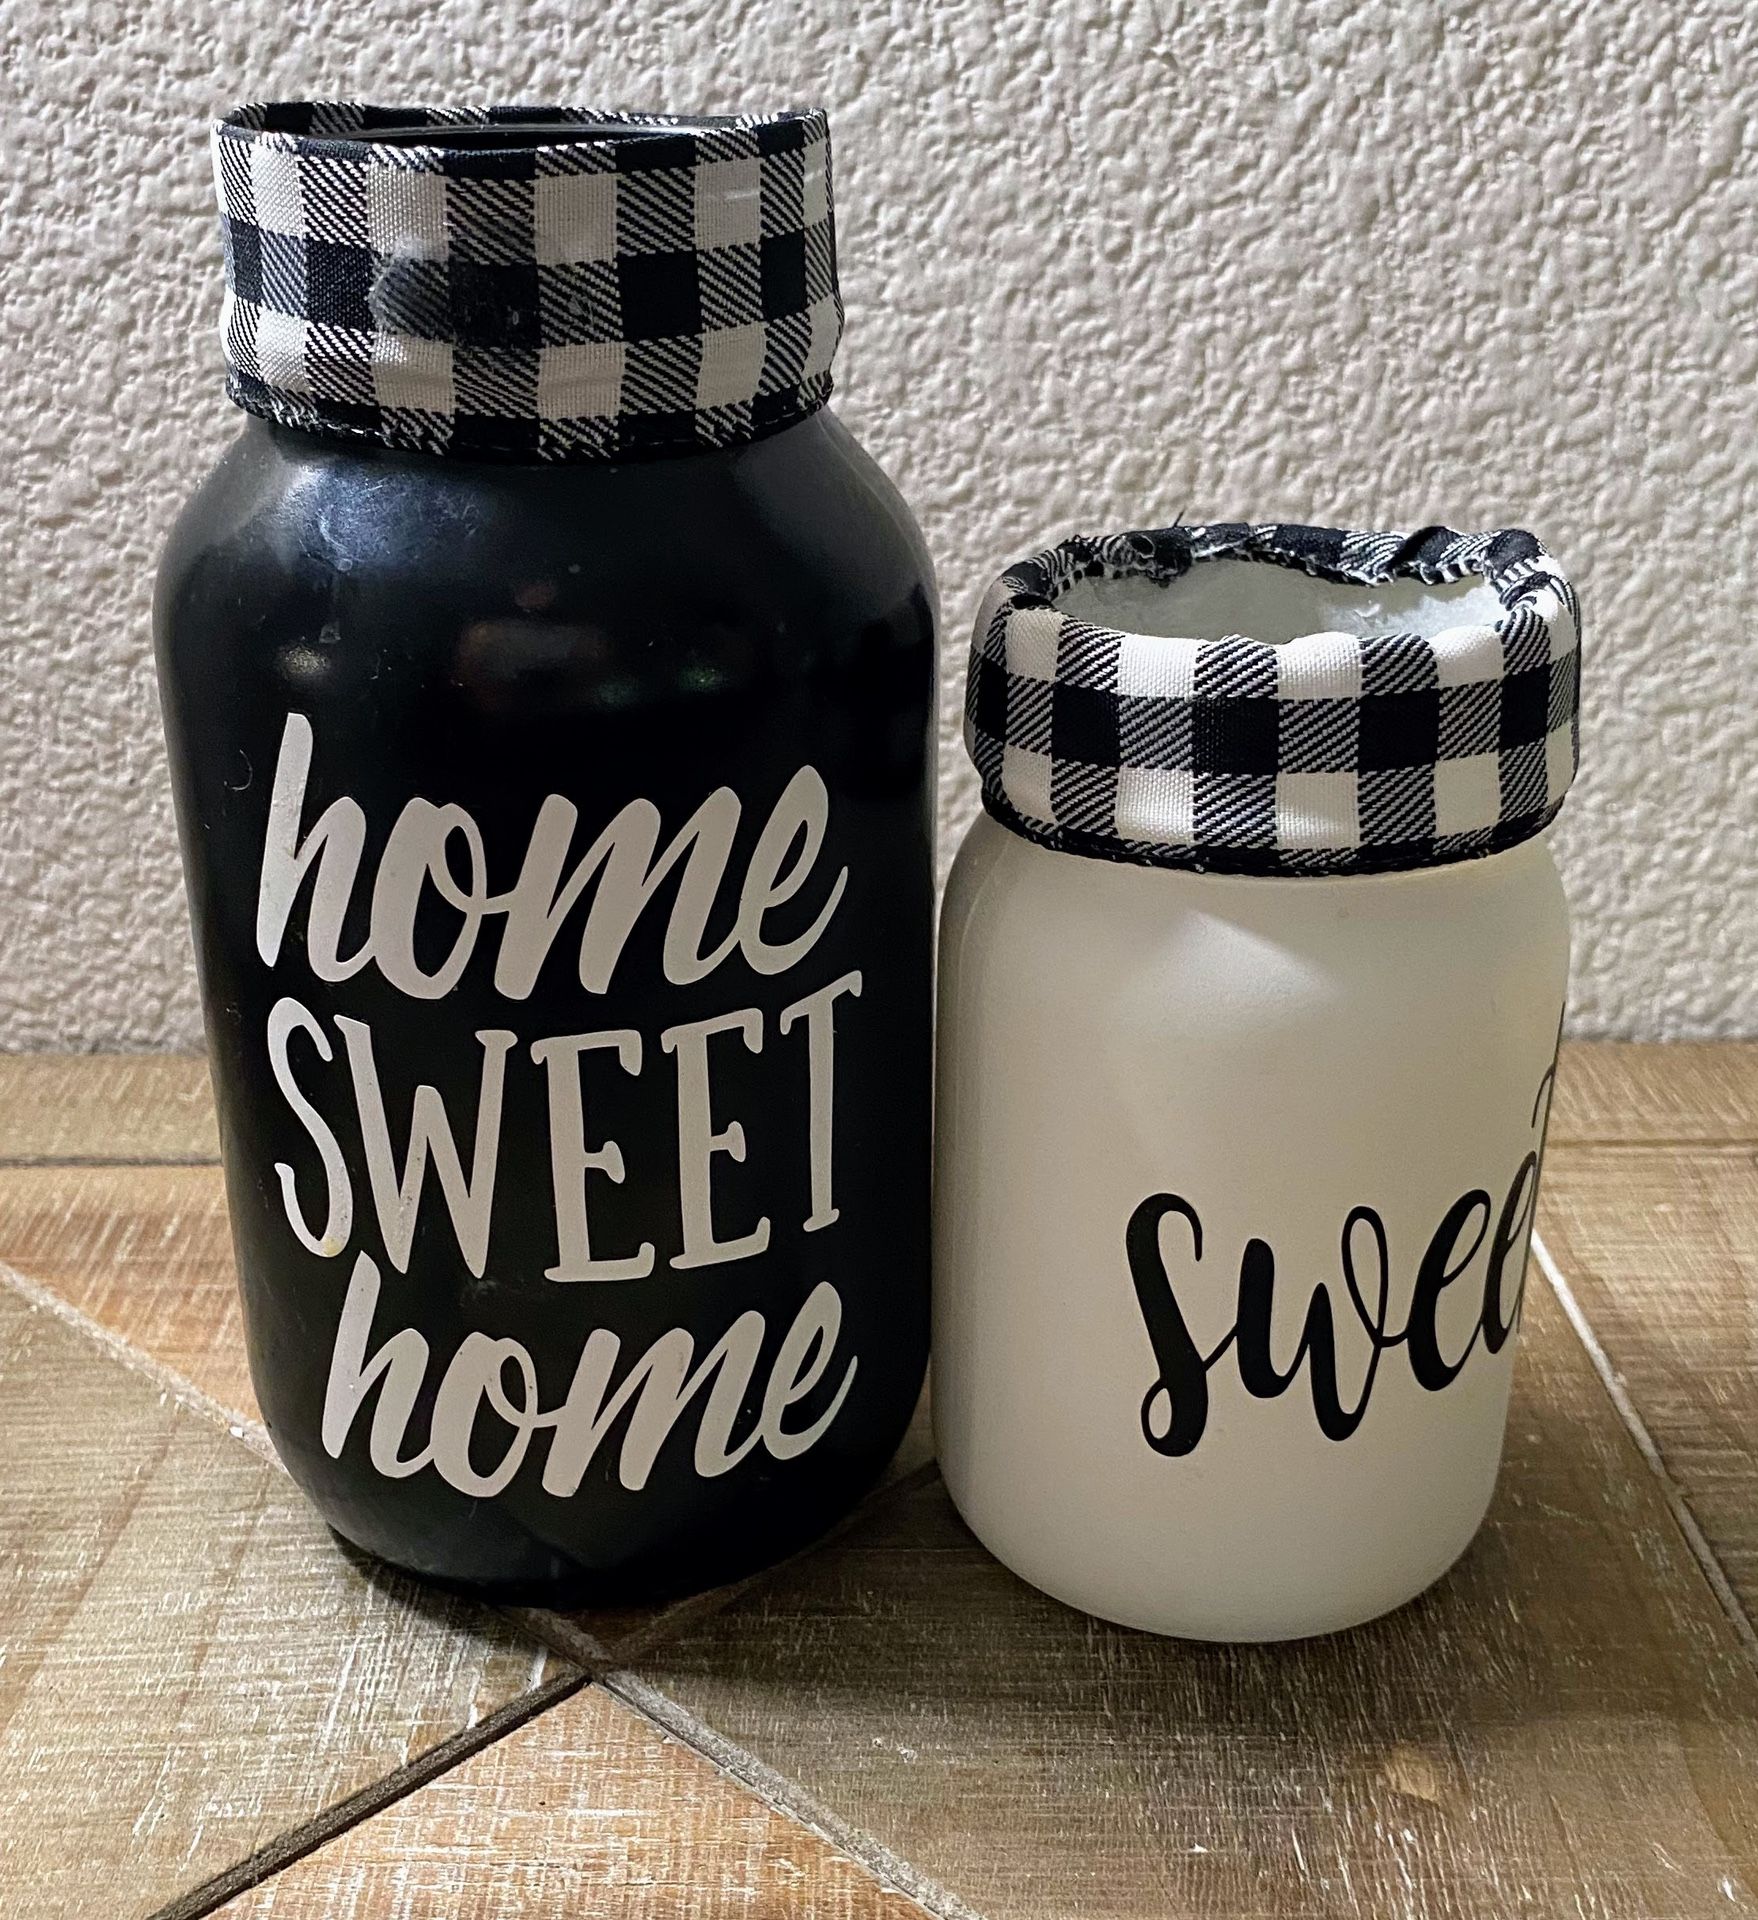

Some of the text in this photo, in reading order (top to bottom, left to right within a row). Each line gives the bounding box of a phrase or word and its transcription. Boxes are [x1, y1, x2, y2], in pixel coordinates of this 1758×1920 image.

[256, 712, 848, 1000] home
[267, 970, 863, 1283] SWEET
[322, 1250, 858, 1498] home
